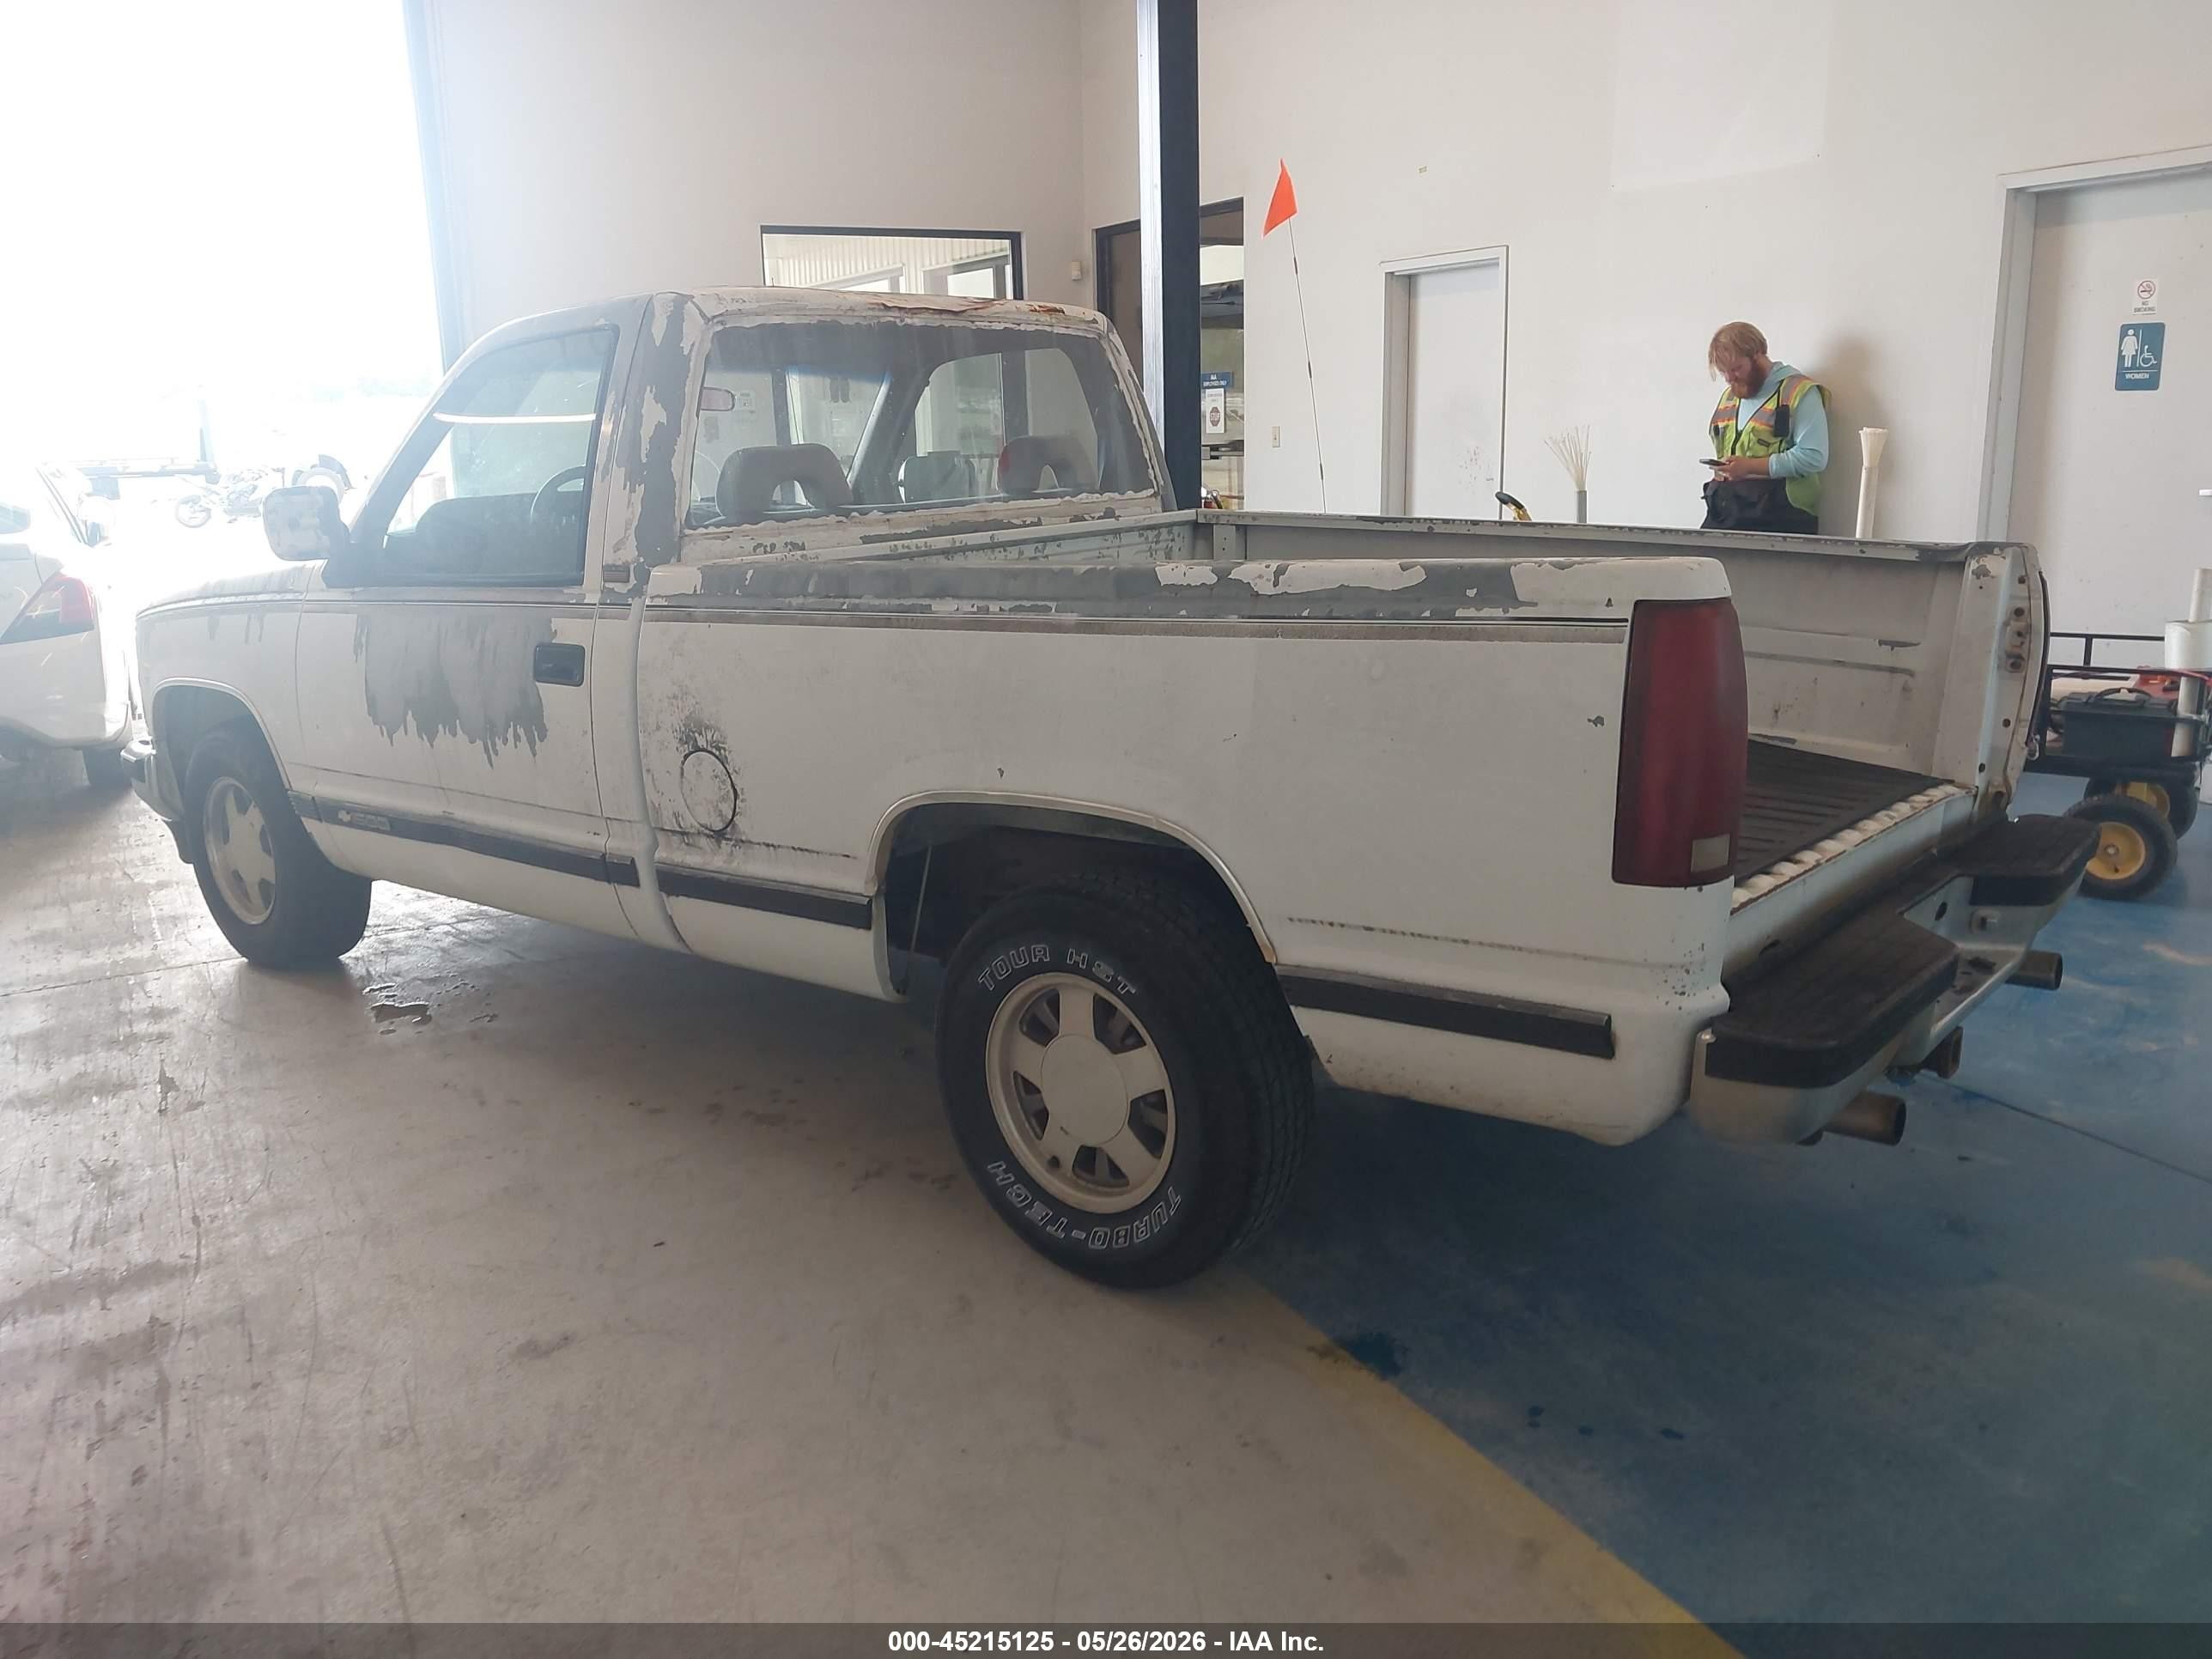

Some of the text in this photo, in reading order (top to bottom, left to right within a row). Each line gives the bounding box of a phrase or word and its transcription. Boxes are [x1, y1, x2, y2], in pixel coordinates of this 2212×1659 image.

[978, 945, 1137, 995] TOUR HST
[987, 1161, 1182, 1250] TURBO-TECH
